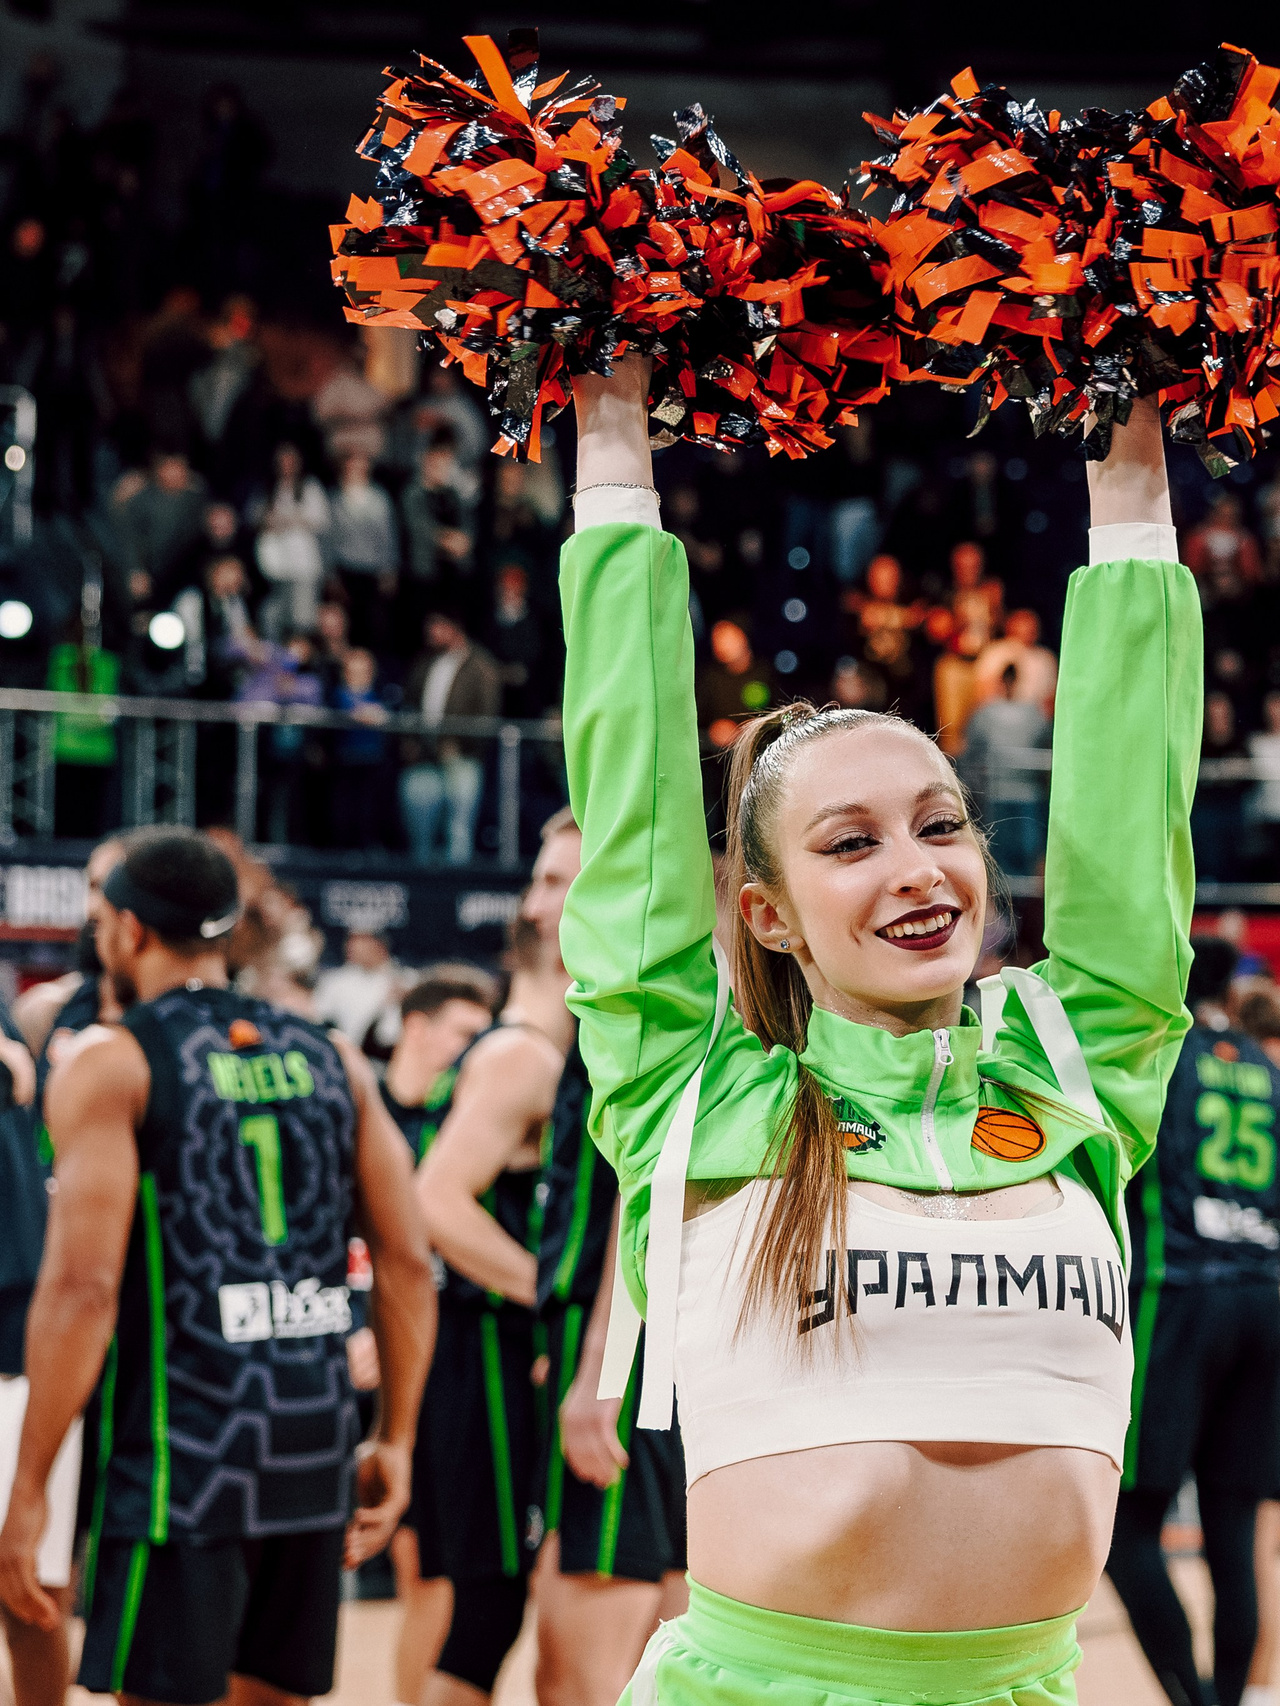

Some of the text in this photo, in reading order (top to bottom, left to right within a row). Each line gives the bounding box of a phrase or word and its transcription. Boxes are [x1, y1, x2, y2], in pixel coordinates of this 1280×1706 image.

[238, 1114, 288, 1246] 1
[837, 1121, 876, 1141] ЛМАШ
[1196, 1091, 1277, 1191] 25
[797, 1248, 1126, 1344] УРАЛМАШ
